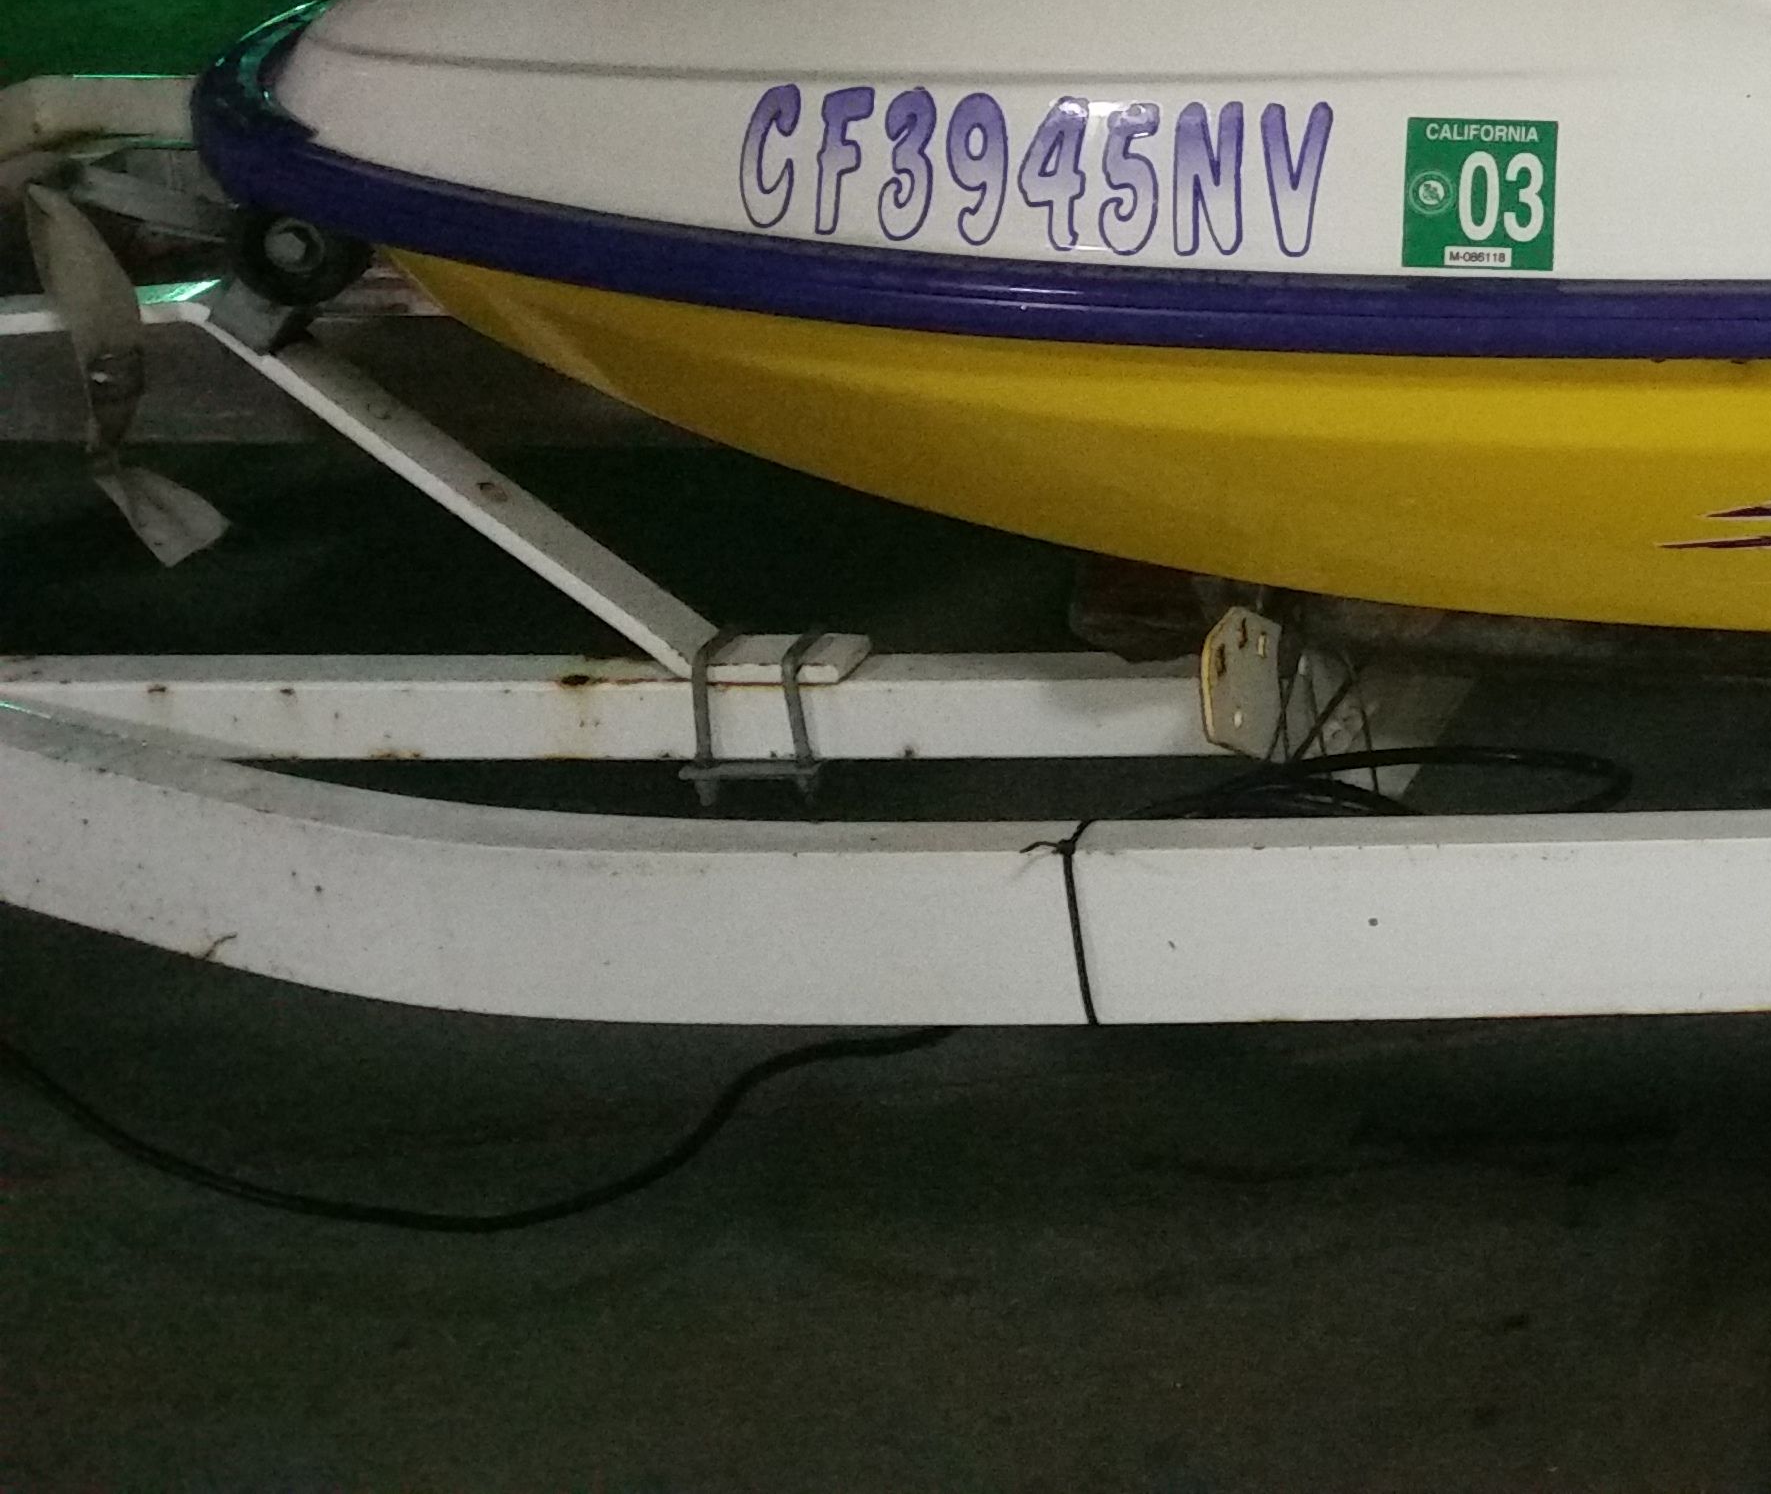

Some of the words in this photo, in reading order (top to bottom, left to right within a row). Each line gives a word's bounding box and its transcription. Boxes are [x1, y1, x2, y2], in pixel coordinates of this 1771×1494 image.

[739, 84, 1334, 256] CF3945NV
[1426, 123, 1539, 142] CALIFORNIA
[1458, 151, 1544, 242] 03
